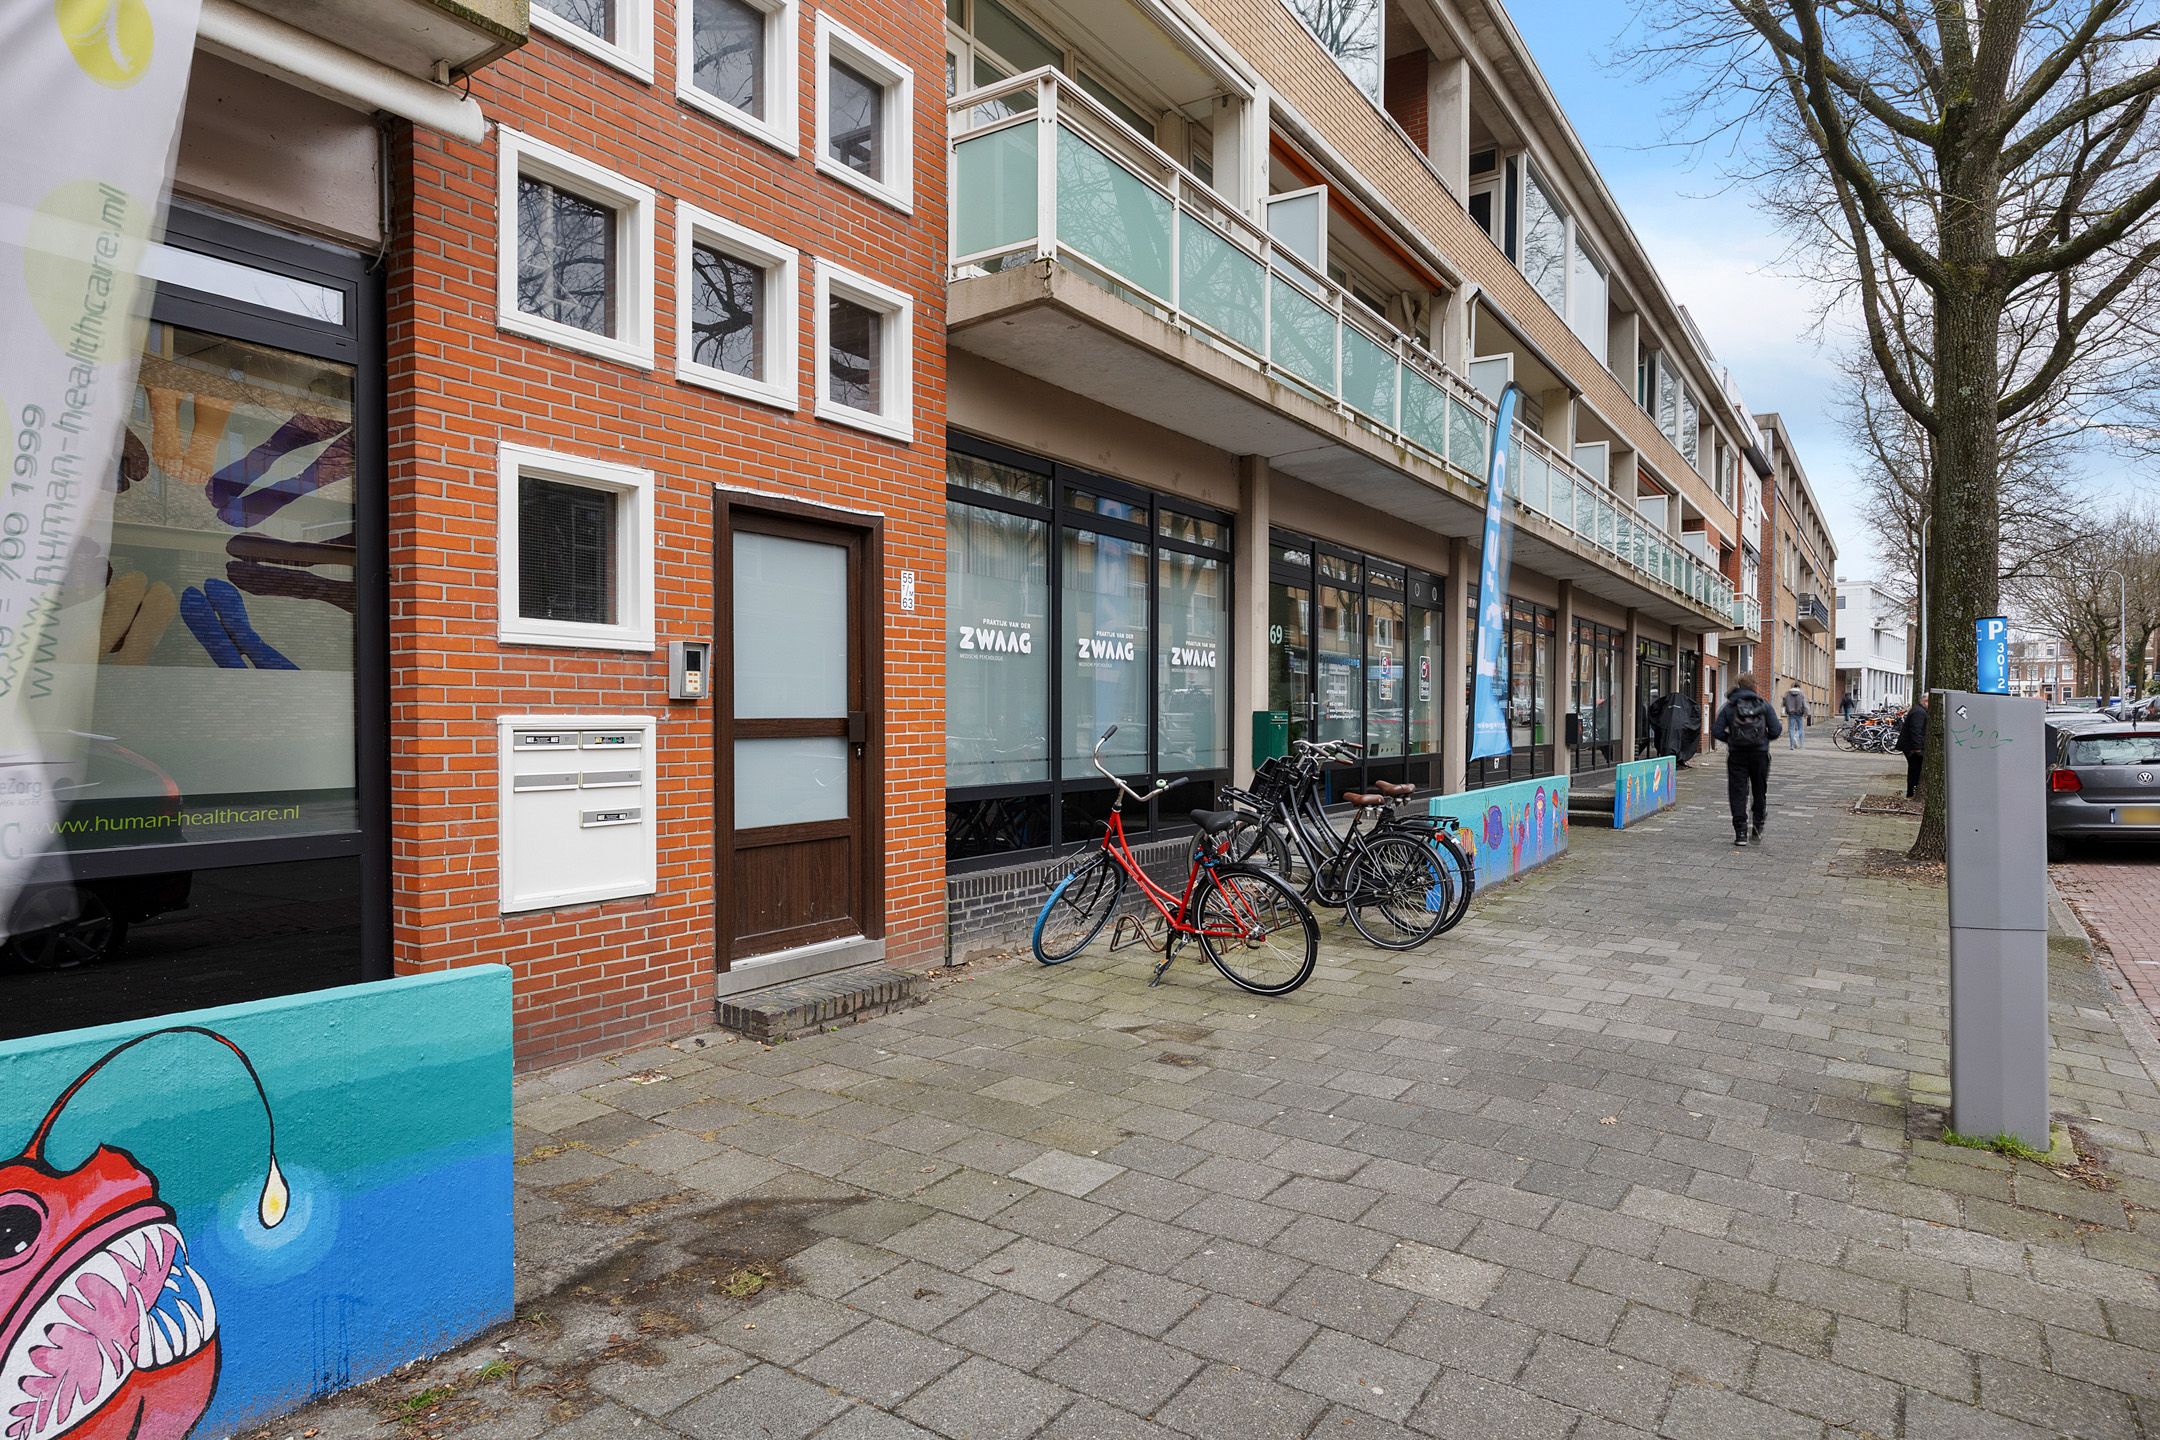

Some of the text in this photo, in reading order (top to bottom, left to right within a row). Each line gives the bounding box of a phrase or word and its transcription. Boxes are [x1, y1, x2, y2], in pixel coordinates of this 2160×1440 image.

[10, 403, 45, 497] 1999
[902, 572, 913, 584] 55
[902, 597, 913, 609] 63
[982, 618, 1007, 627] PRAKTIJK
[1988, 621, 2004, 640] P
[959, 625, 1032, 654] ZWAAG
[1269, 624, 1283, 644] 69
[1078, 638, 1134, 661] ZWAAG
[1171, 647, 1216, 668] ZWAAG
[1997, 643, 2006, 689] 3012
